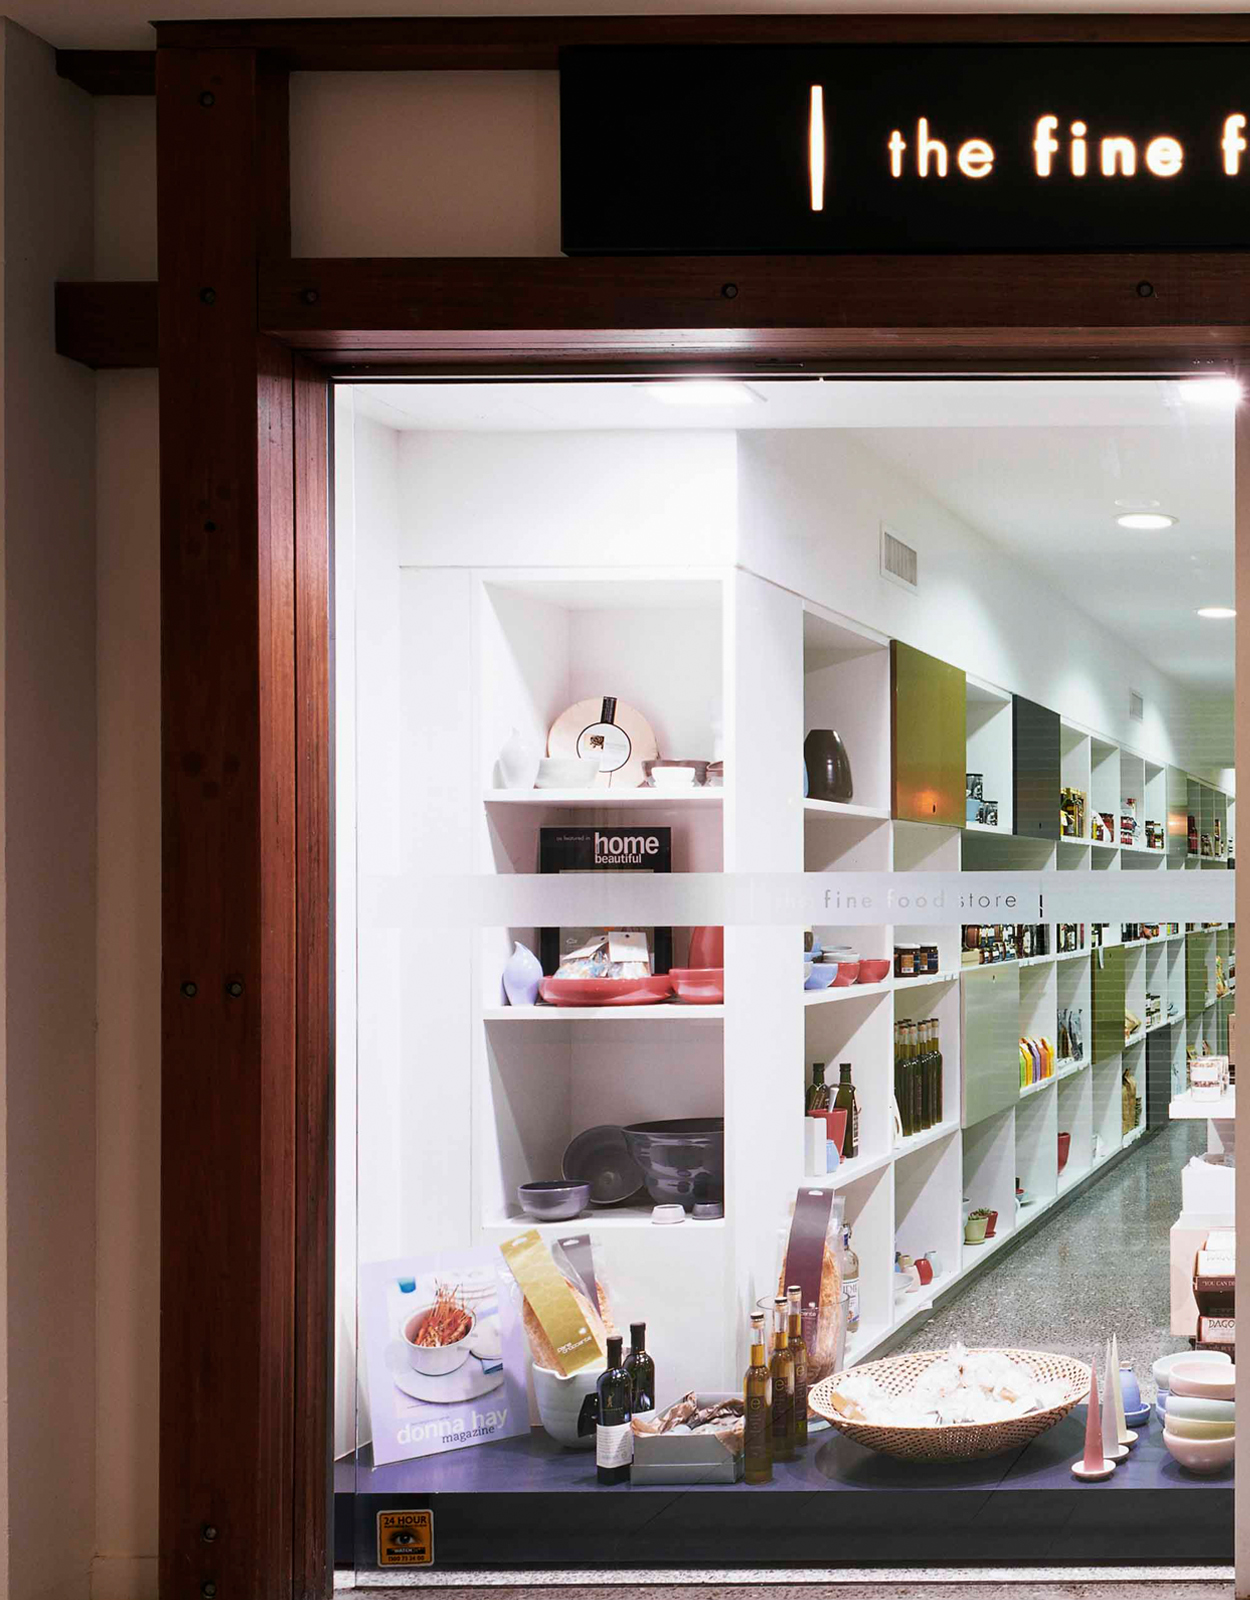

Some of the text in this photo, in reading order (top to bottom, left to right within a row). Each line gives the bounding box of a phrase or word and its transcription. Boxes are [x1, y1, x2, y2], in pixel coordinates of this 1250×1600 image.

[888, 118, 994, 178] the
[1033, 115, 1183, 177] fine
[594, 832, 659, 854] home
[594, 853, 642, 864] beautiful
[824, 889, 873, 909] fine
[887, 888, 946, 909] food
[959, 892, 1018, 909] store
[750, 1397, 761, 1410] e
[397, 1408, 507, 1445] donna hay
[442, 1425, 495, 1443] magazine
[384, 1516, 427, 1525] 24 HOUR
